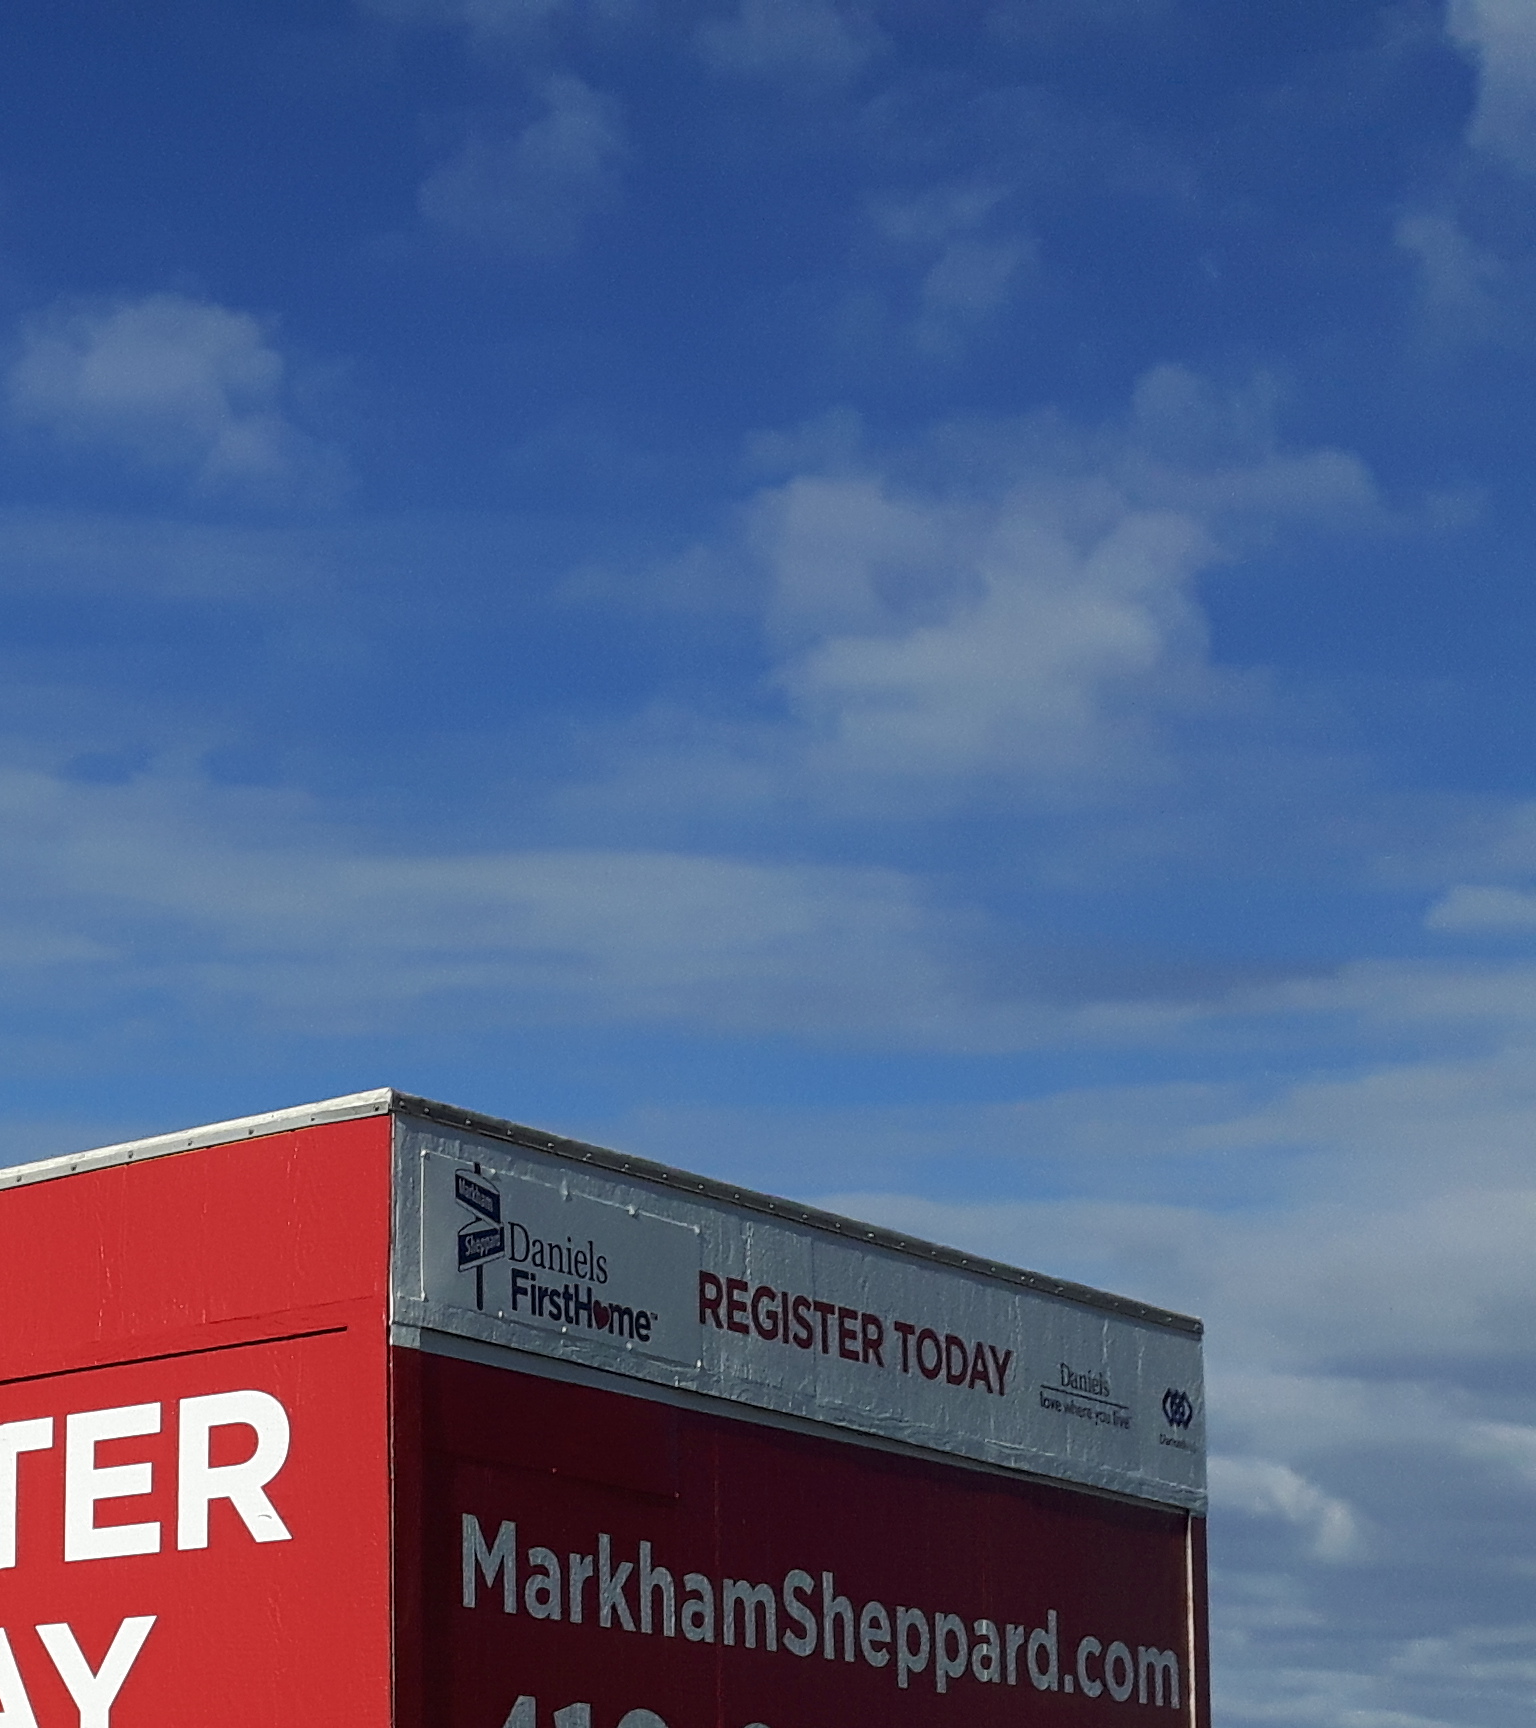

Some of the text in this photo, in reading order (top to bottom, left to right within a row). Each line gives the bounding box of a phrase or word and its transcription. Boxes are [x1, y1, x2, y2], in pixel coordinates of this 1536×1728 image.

[508, 1221, 609, 1284] Daniels
[699, 1270, 1013, 1396] REGISTER TODAY
[1060, 1362, 1110, 1397] Daniels
[461, 1512, 1181, 1709] MarkhamSheppard.com
